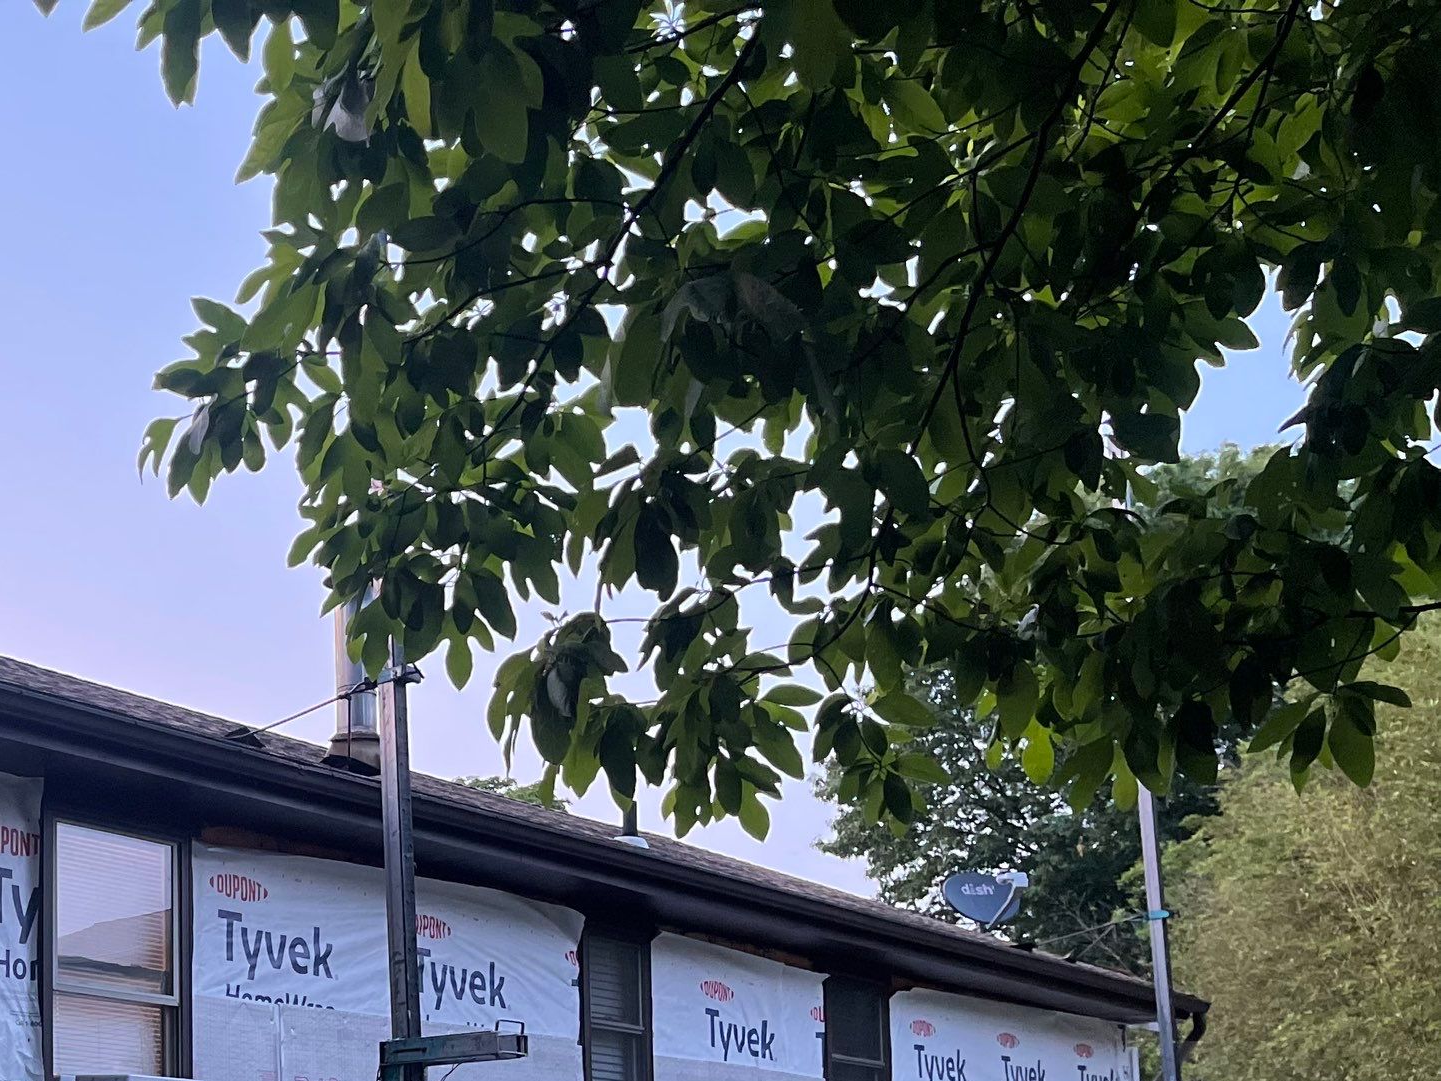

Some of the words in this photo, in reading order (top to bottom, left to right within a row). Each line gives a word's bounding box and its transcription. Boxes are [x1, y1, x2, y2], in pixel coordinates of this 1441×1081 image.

[216, 873, 262, 902] DUPONT
[961, 883, 994, 895] dish
[218, 909, 333, 981] Tyvek
[417, 947, 507, 1011] Tyvek
[704, 1007, 775, 1062] Tyvek
